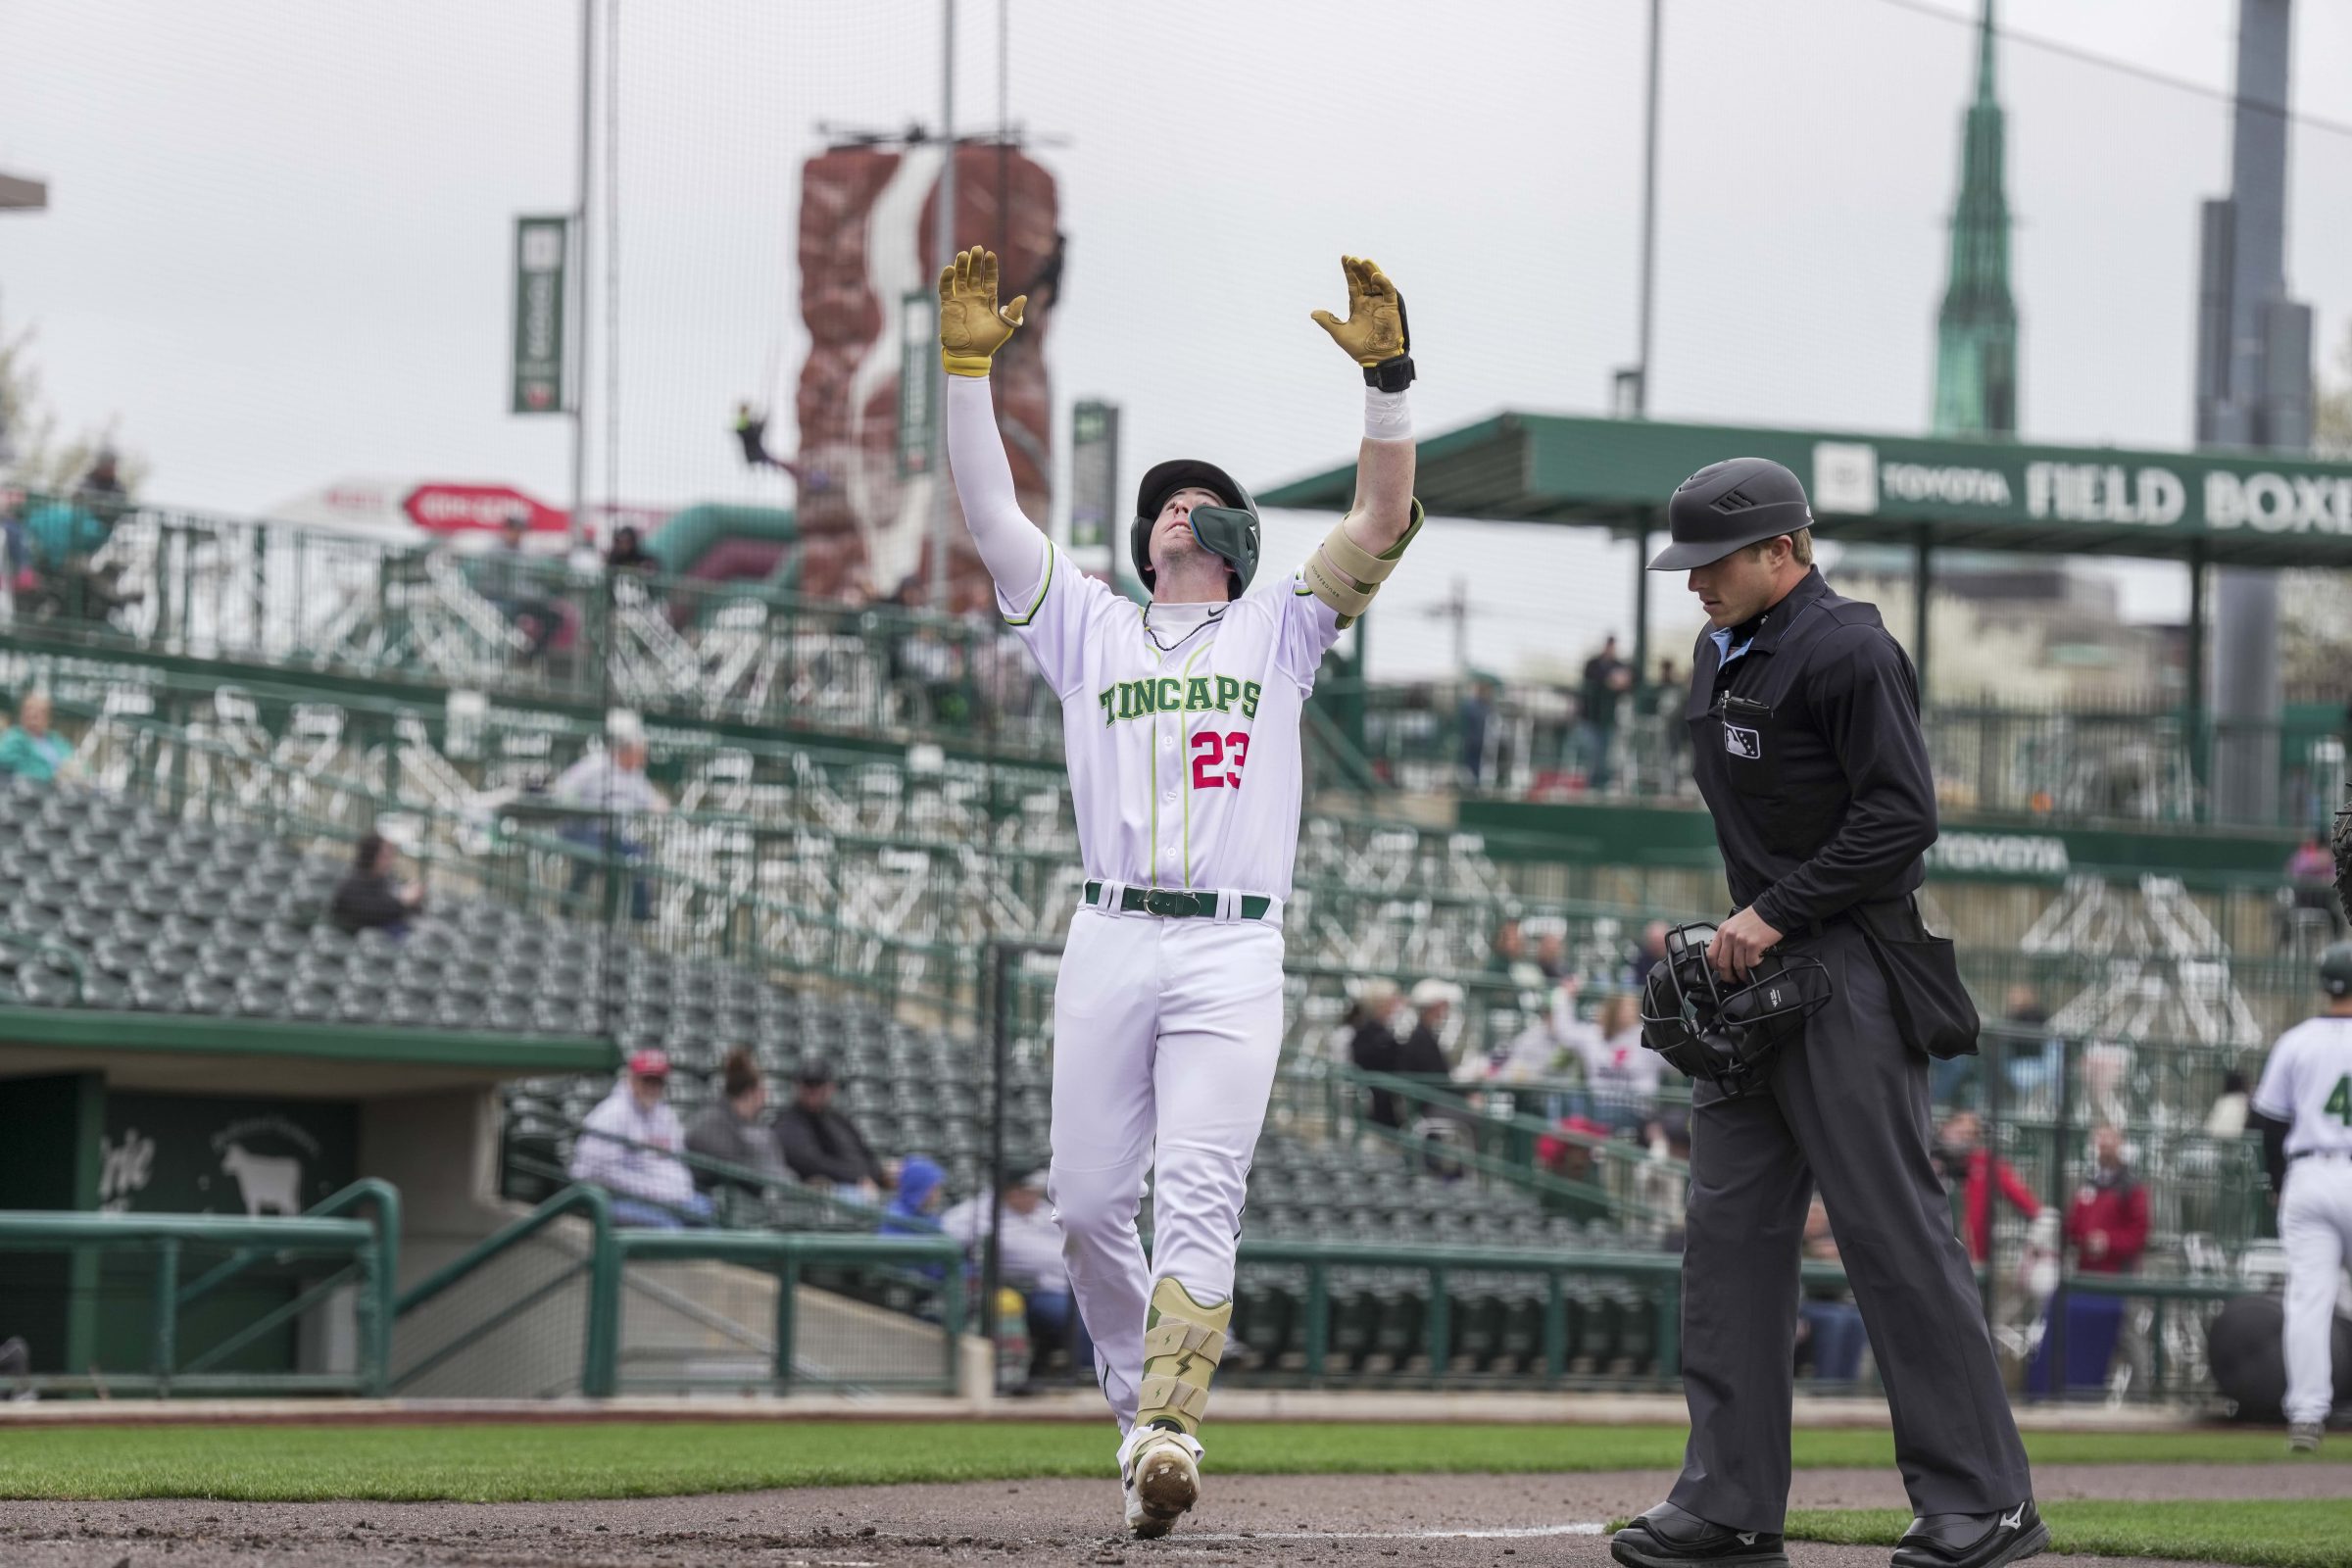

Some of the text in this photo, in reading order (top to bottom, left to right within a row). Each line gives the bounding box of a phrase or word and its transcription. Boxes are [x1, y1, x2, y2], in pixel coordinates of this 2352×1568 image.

[1883, 463, 2011, 507] TOYOTA
[2026, 461, 2186, 526] FIELD
[1099, 673, 1262, 729] TINCAPS
[1191, 731, 1250, 789] 23
[2324, 1072, 2352, 1127] 4
